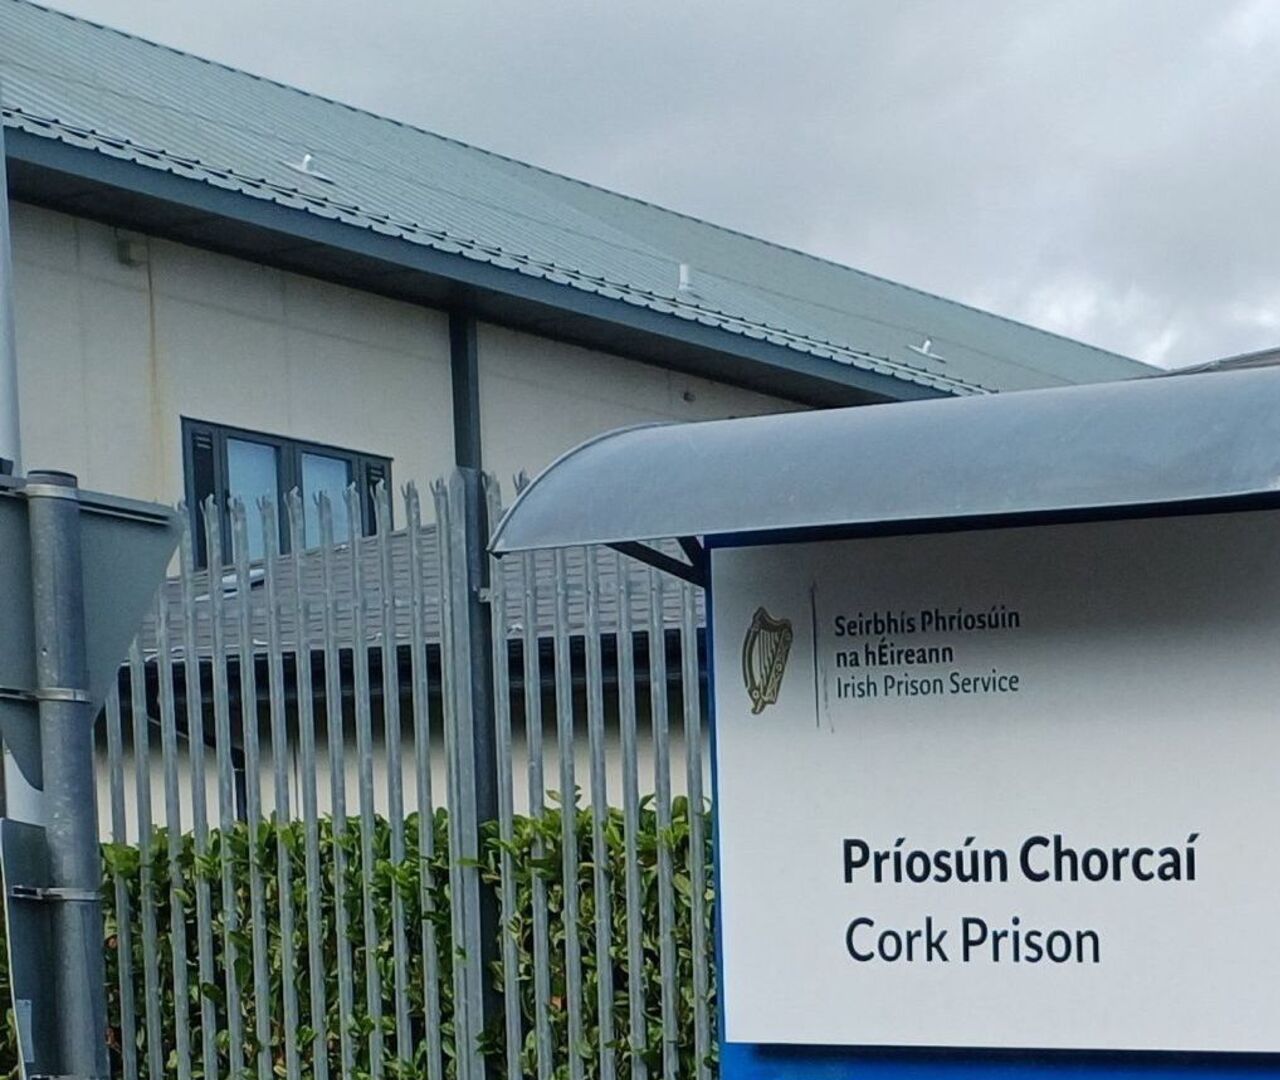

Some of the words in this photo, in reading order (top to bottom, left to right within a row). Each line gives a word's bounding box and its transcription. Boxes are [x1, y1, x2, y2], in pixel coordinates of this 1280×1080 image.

[834, 611, 916, 637] Seirbhís
[920, 606, 1021, 633] Phríosúin
[836, 651, 860, 668] na
[864, 637, 954, 667] hÉireann
[837, 674, 878, 699] Irish
[883, 673, 944, 697] Prison
[949, 669, 1020, 694] Service
[843, 837, 1008, 884] Príosún
[1019, 833, 1200, 883] Chorcaí
[845, 916, 949, 963] Cork
[961, 916, 1101, 964] Prison
